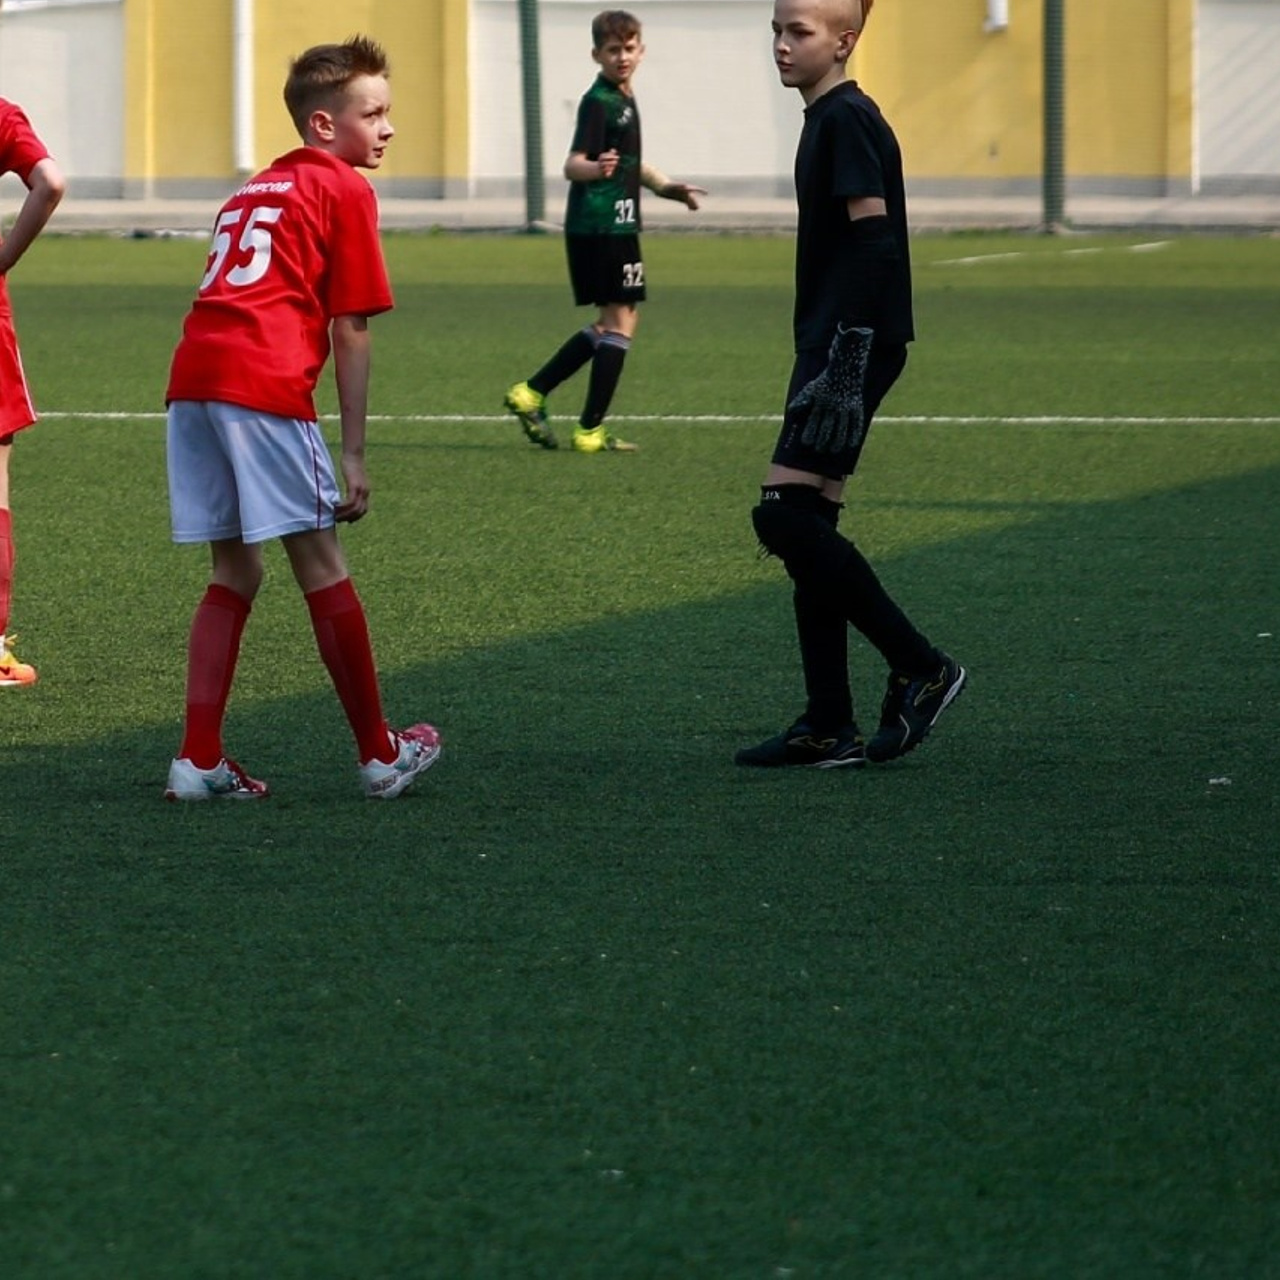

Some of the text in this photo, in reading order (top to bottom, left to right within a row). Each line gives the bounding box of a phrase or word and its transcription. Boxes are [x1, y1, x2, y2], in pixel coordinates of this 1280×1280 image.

[614, 198, 635, 224] 32
[198, 206, 283, 291] 55
[623, 262, 644, 287] 32
